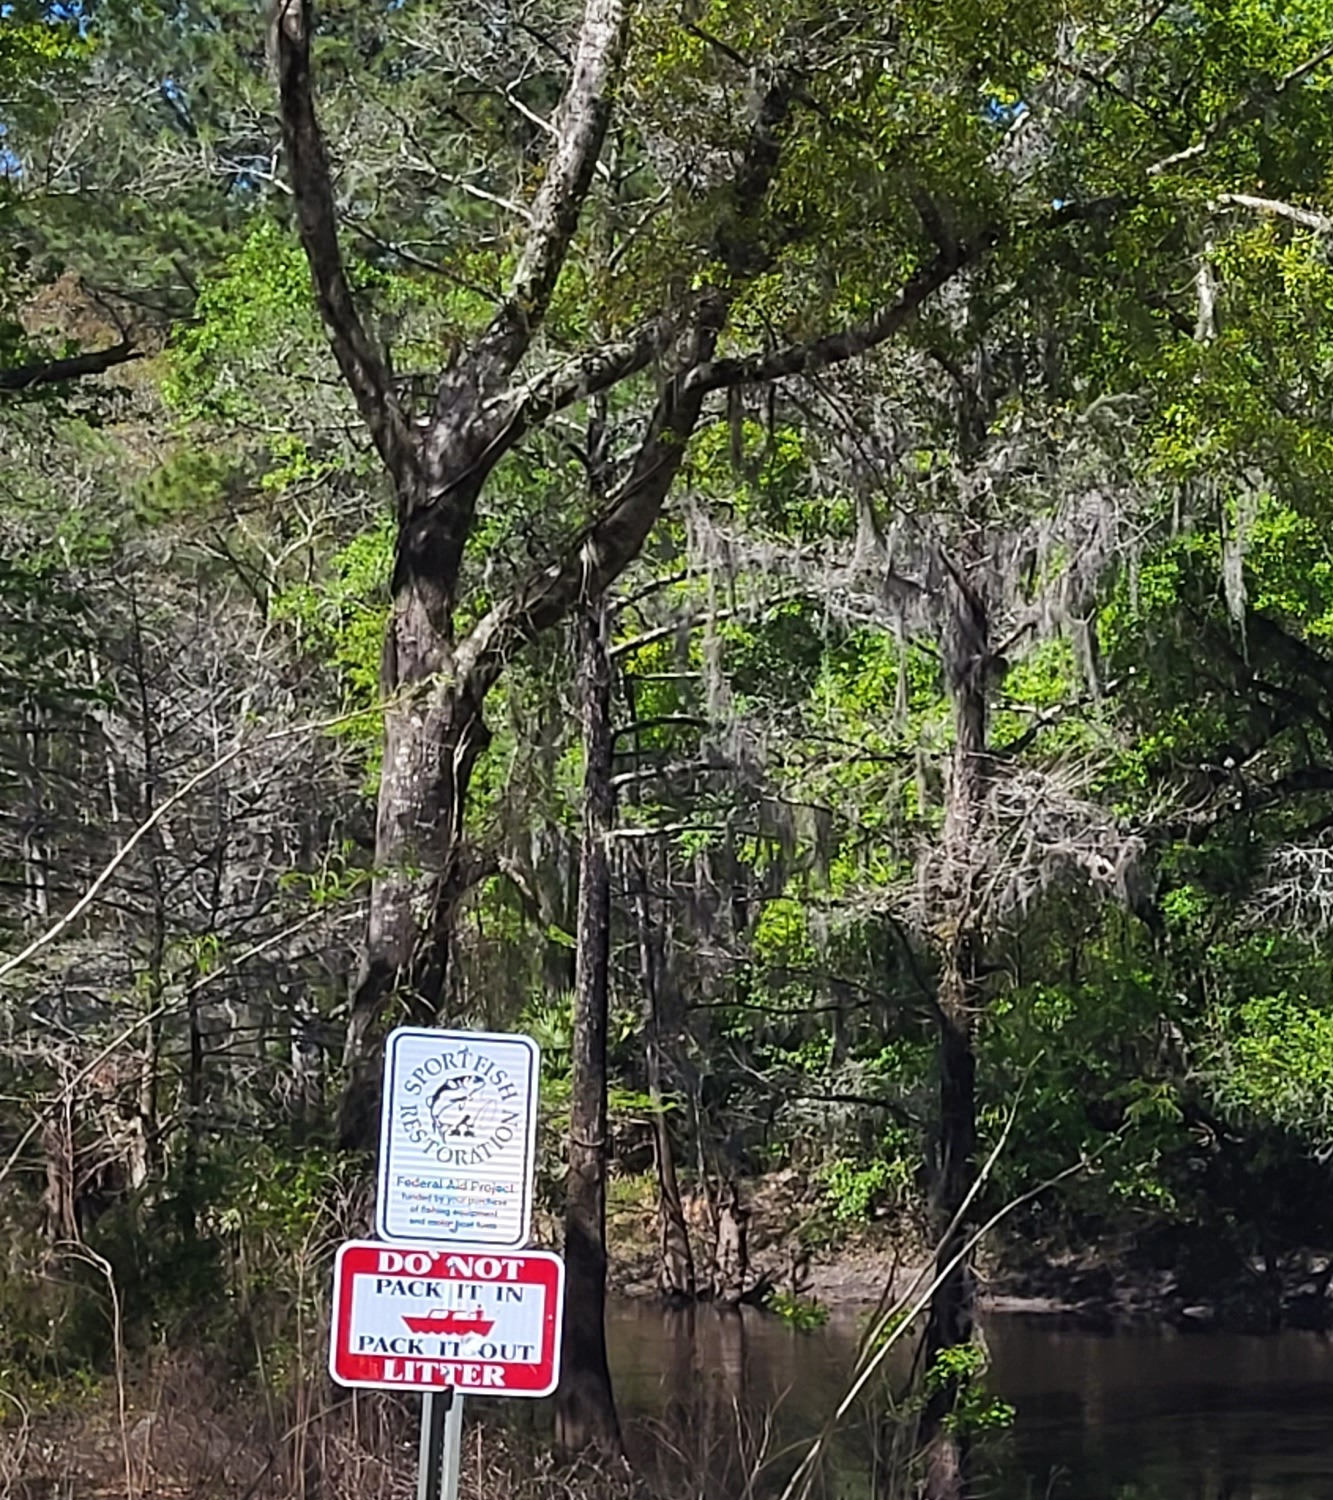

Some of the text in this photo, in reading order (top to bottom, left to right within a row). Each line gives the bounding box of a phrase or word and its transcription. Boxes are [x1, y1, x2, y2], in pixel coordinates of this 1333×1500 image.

[404, 1049, 518, 1100] SPORT FISH
[400, 1105, 520, 1165] RESTORATION
[397, 1175, 514, 1195] Federal Aid Project
[377, 1251, 525, 1280] DO NOT
[376, 1278, 524, 1303] PACK IT IN
[358, 1335, 535, 1361] PACK IT OUT
[384, 1359, 506, 1387] LITTER
